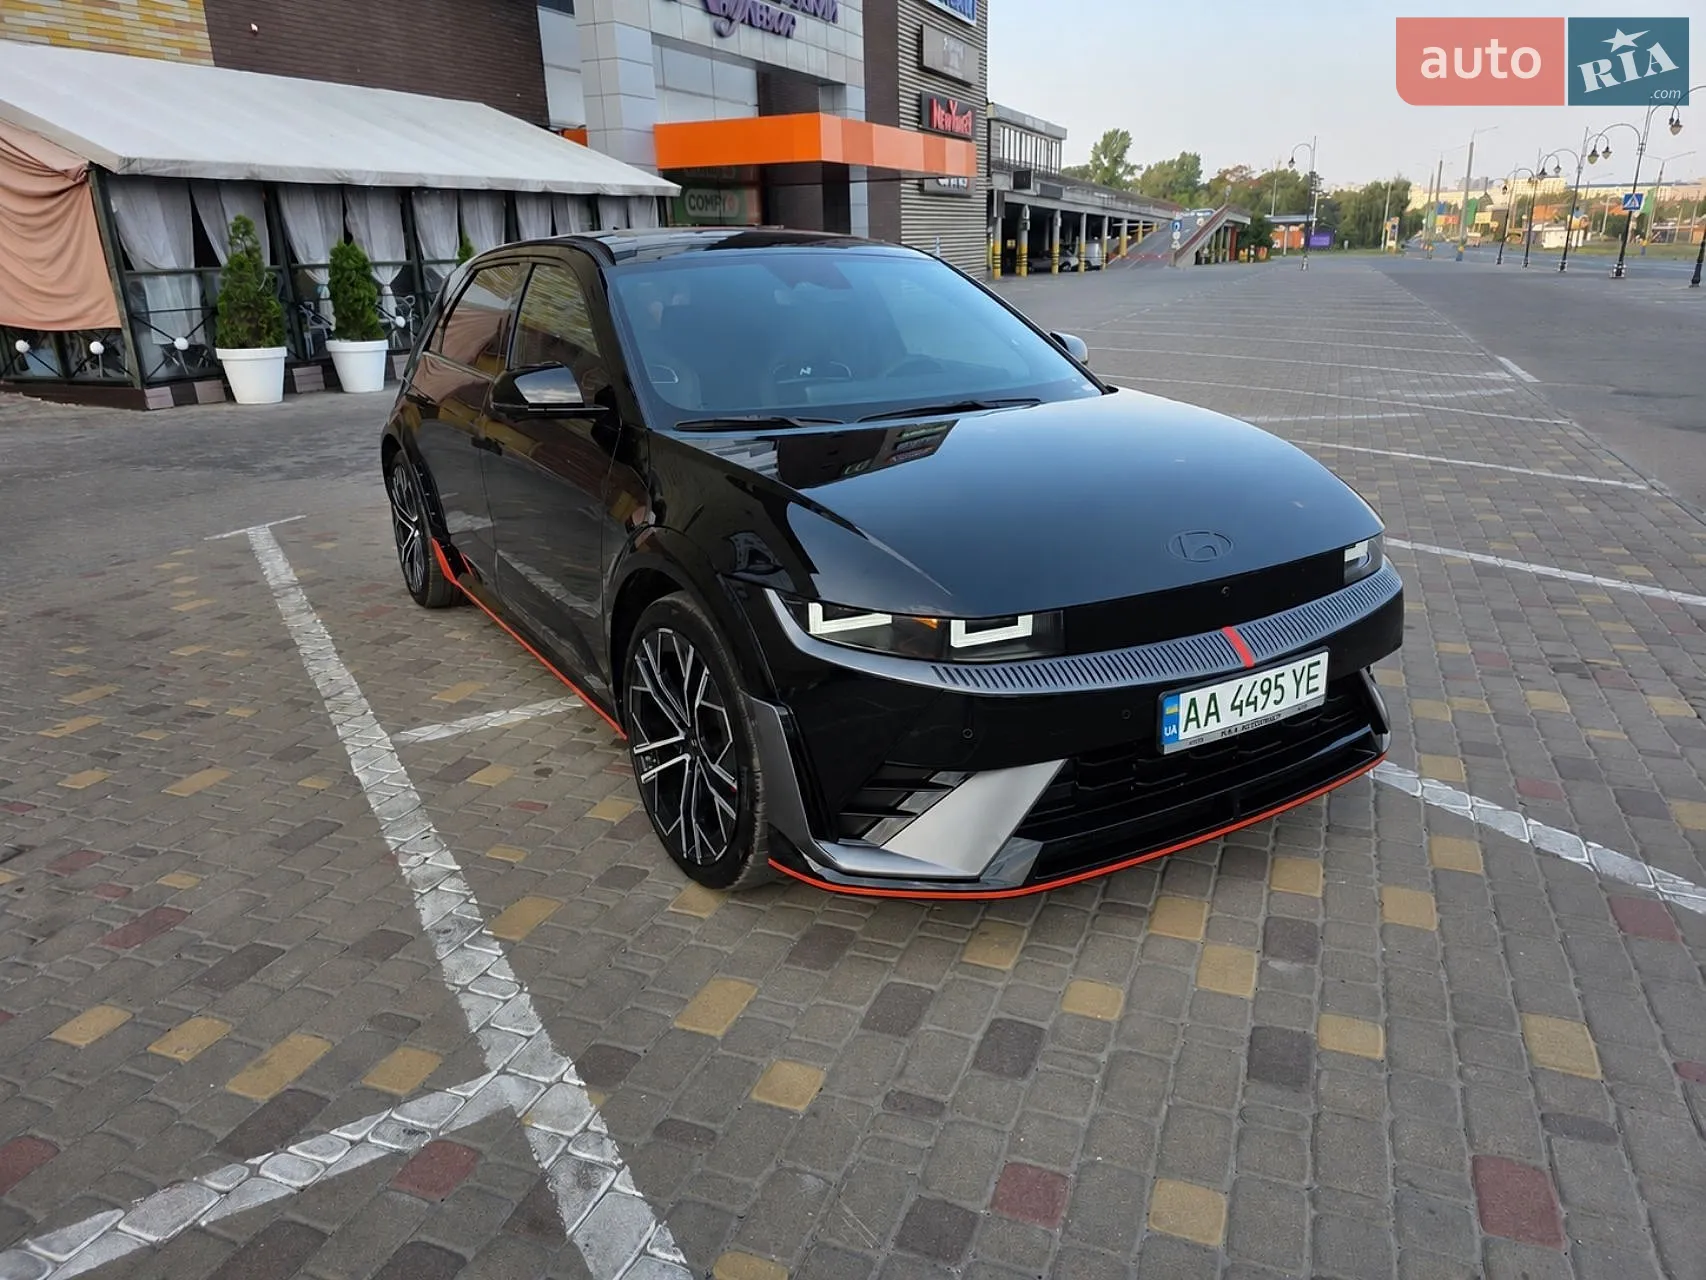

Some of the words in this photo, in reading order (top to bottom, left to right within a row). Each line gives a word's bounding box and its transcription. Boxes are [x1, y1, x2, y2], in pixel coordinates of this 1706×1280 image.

[1183, 692, 1221, 732] AA
[1231, 673, 1285, 717] 4495
[1292, 661, 1321, 699] YE
[1163, 726, 1177, 737] UA
